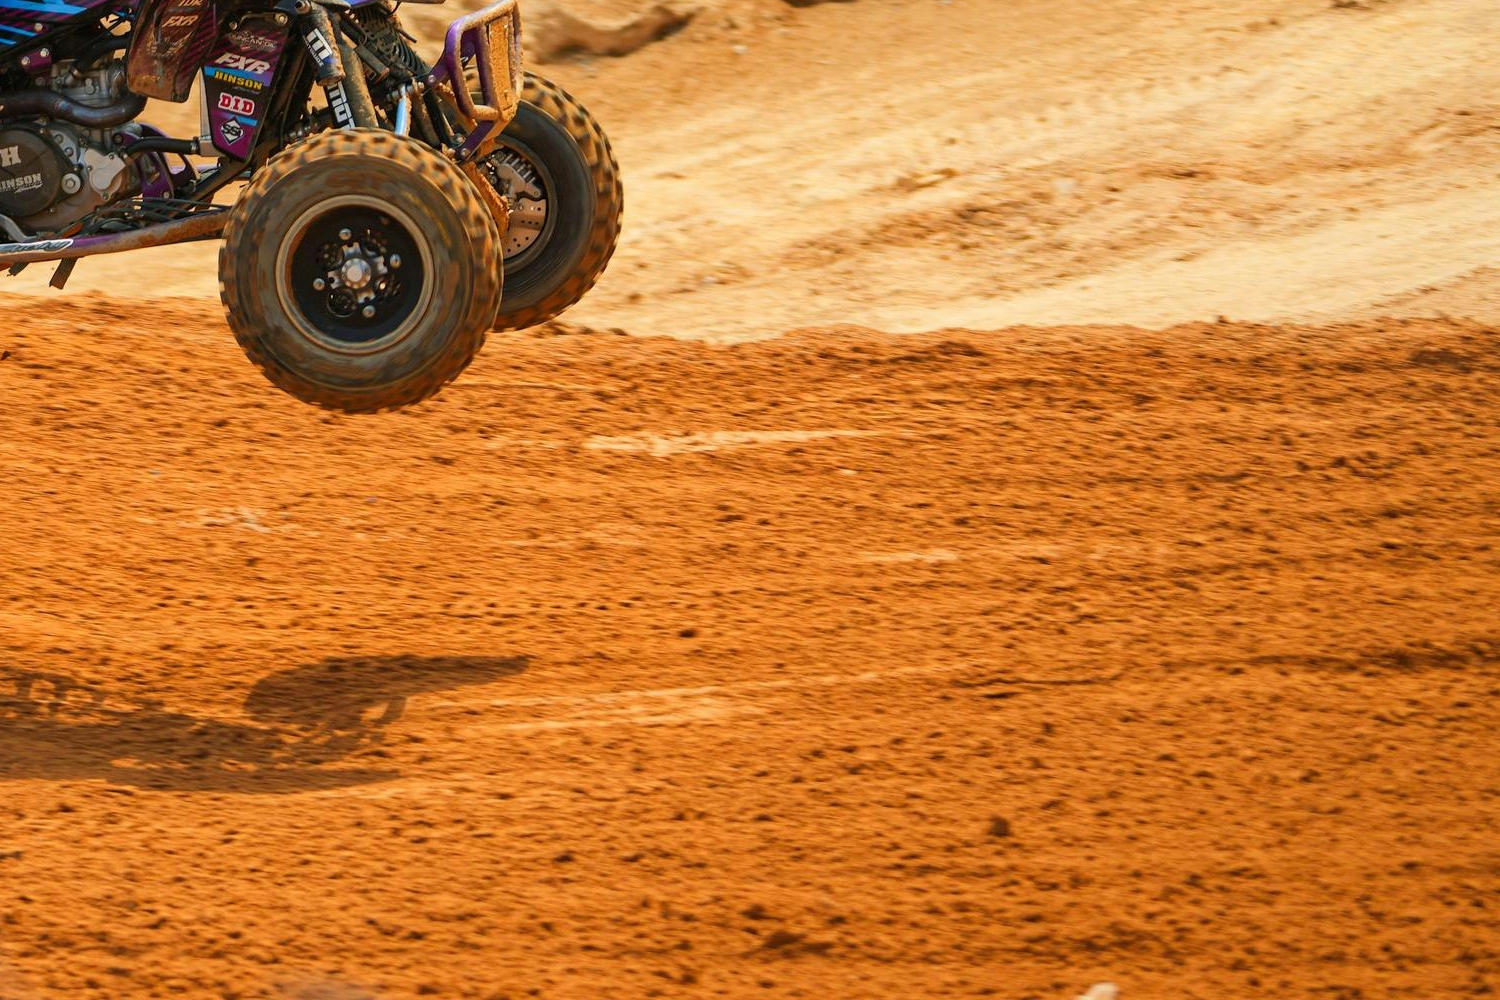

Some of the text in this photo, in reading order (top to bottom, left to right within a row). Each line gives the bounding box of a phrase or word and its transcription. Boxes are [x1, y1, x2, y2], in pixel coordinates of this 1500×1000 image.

[161, 14, 199, 28] FXR
[214, 52, 270, 75] FXR
[213, 70, 263, 91] HINSON
[0, 145, 22, 168] H
